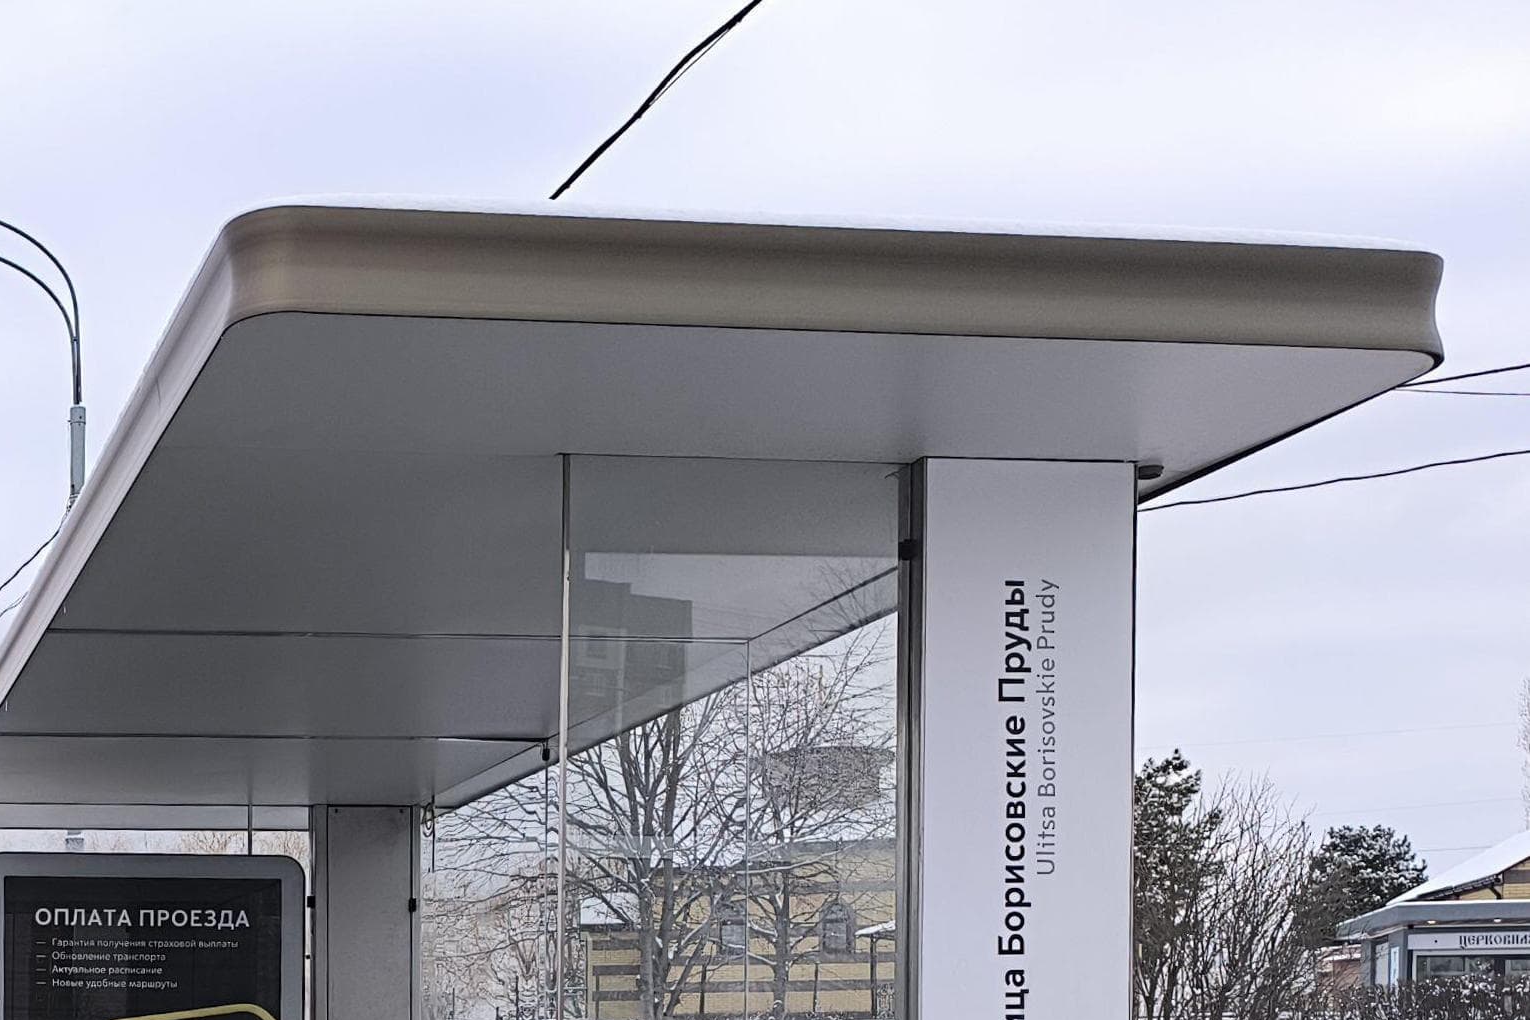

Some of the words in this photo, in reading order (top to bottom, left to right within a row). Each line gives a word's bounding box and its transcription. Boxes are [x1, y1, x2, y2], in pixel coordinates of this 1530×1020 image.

[1036, 579, 1060, 650] Prudy
[998, 580, 1032, 702] Пруды
[1036, 658, 1056, 797] Borisovskie
[998, 715, 1032, 955] Борисовские
[1036, 806, 1056, 875] Ulitsa
[35, 908, 132, 927] ОПЛАТА
[139, 909, 250, 930] ПРОЕЗДА
[52, 937, 95, 949] Гарантия
[97, 939, 146, 949] получения
[148, 939, 196, 949] страховой
[198, 940, 239, 950] выплаты
[1459, 934, 1530, 950] ЦЕРКОВНА
[52, 951, 111, 961] Обновление
[112, 953, 166, 962] транспорта
[51, 964, 107, 975] Актуальное
[108, 967, 163, 976] расписание
[52, 978, 84, 987] Новые
[85, 978, 127, 989] удобные
[129, 980, 178, 989] маршруты
